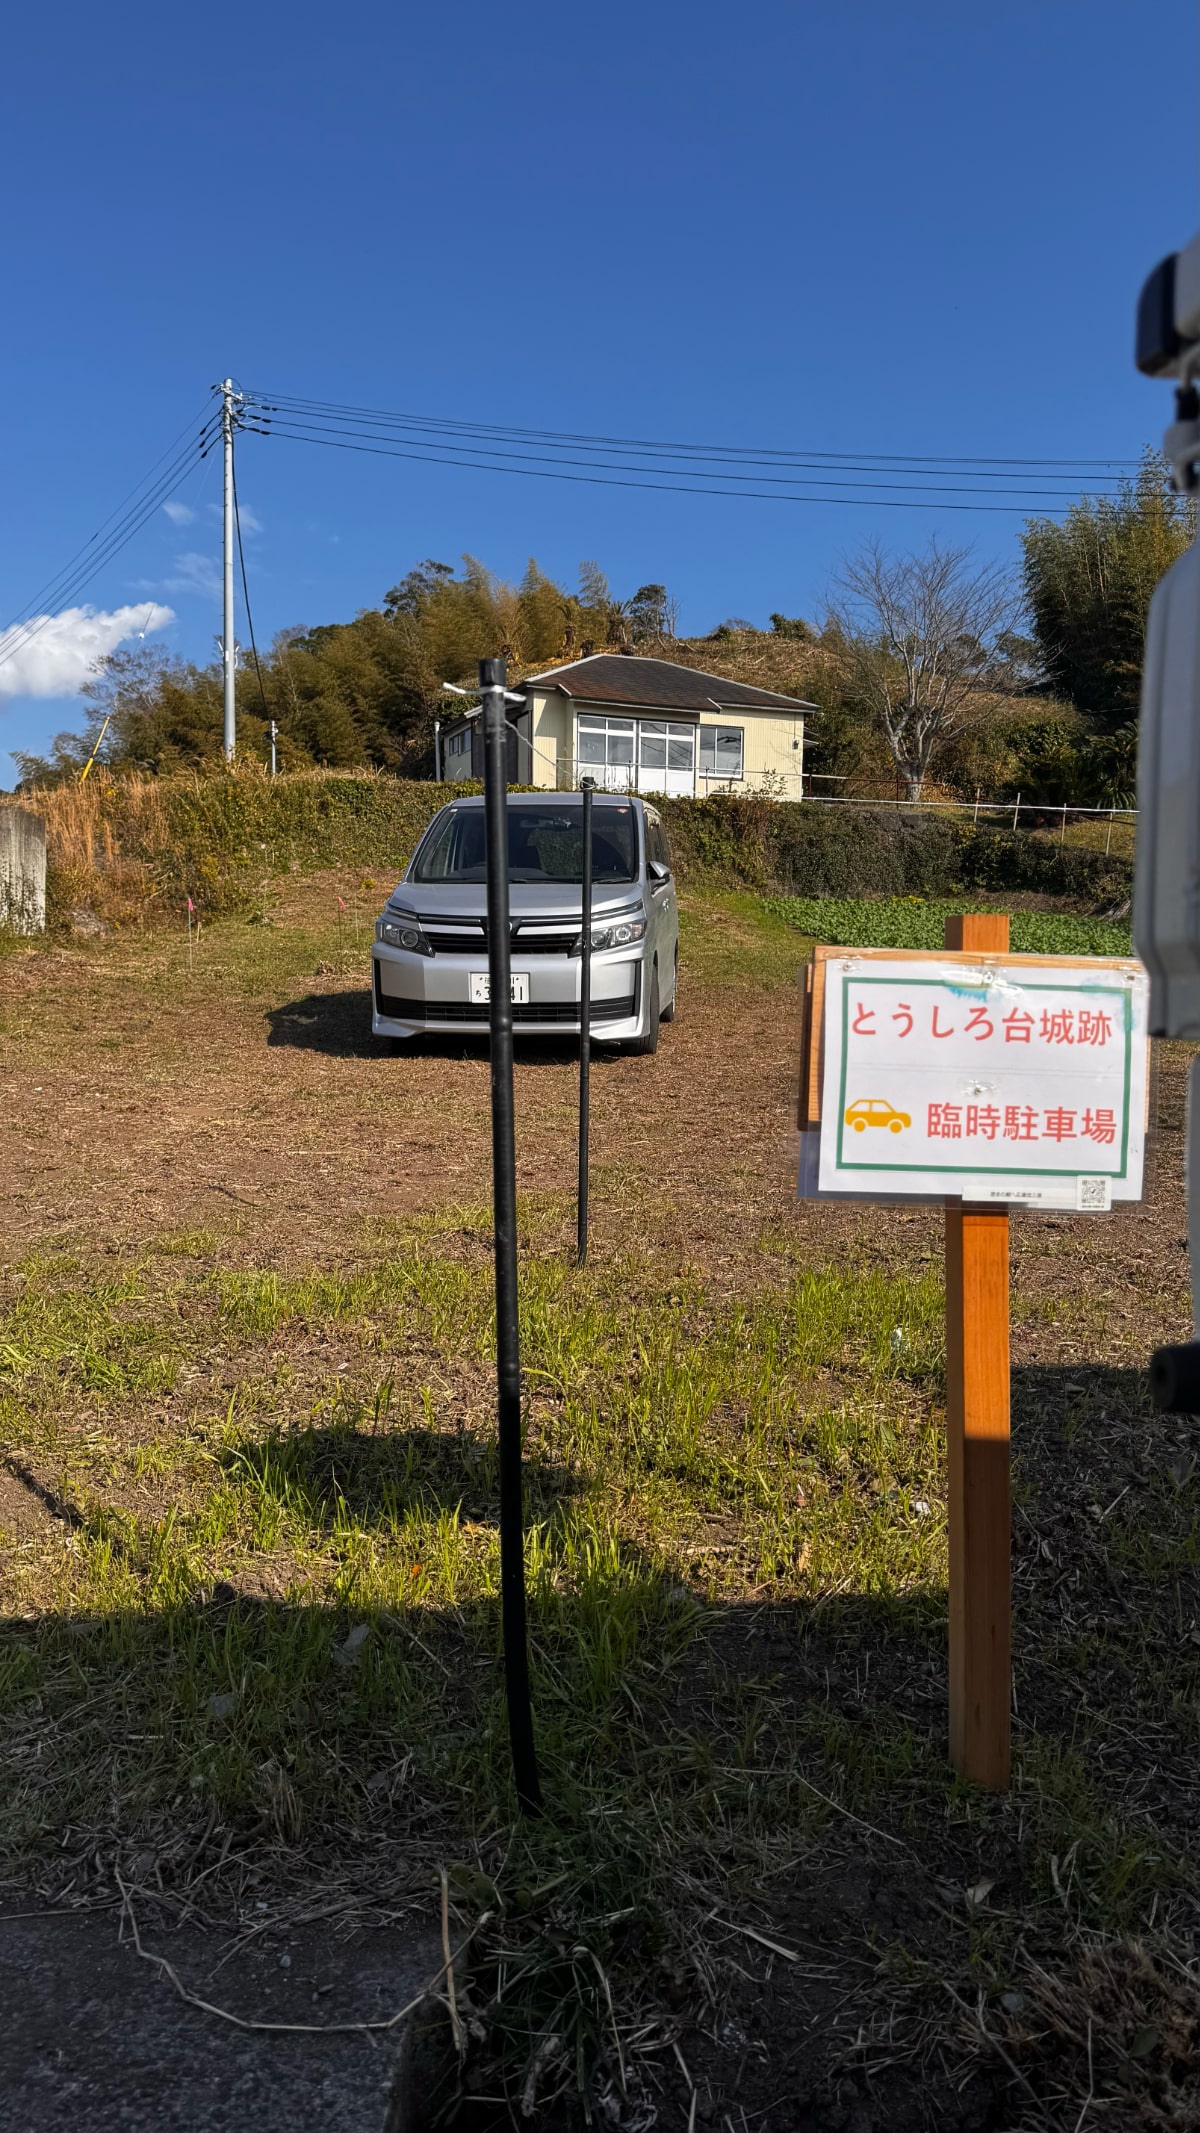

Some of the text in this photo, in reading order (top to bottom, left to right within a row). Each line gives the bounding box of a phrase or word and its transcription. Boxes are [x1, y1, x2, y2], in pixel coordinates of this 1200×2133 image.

[851, 1002, 1113, 1046] とうしろ台城跡
[926, 1102, 1118, 1144] 臨時駐車場
